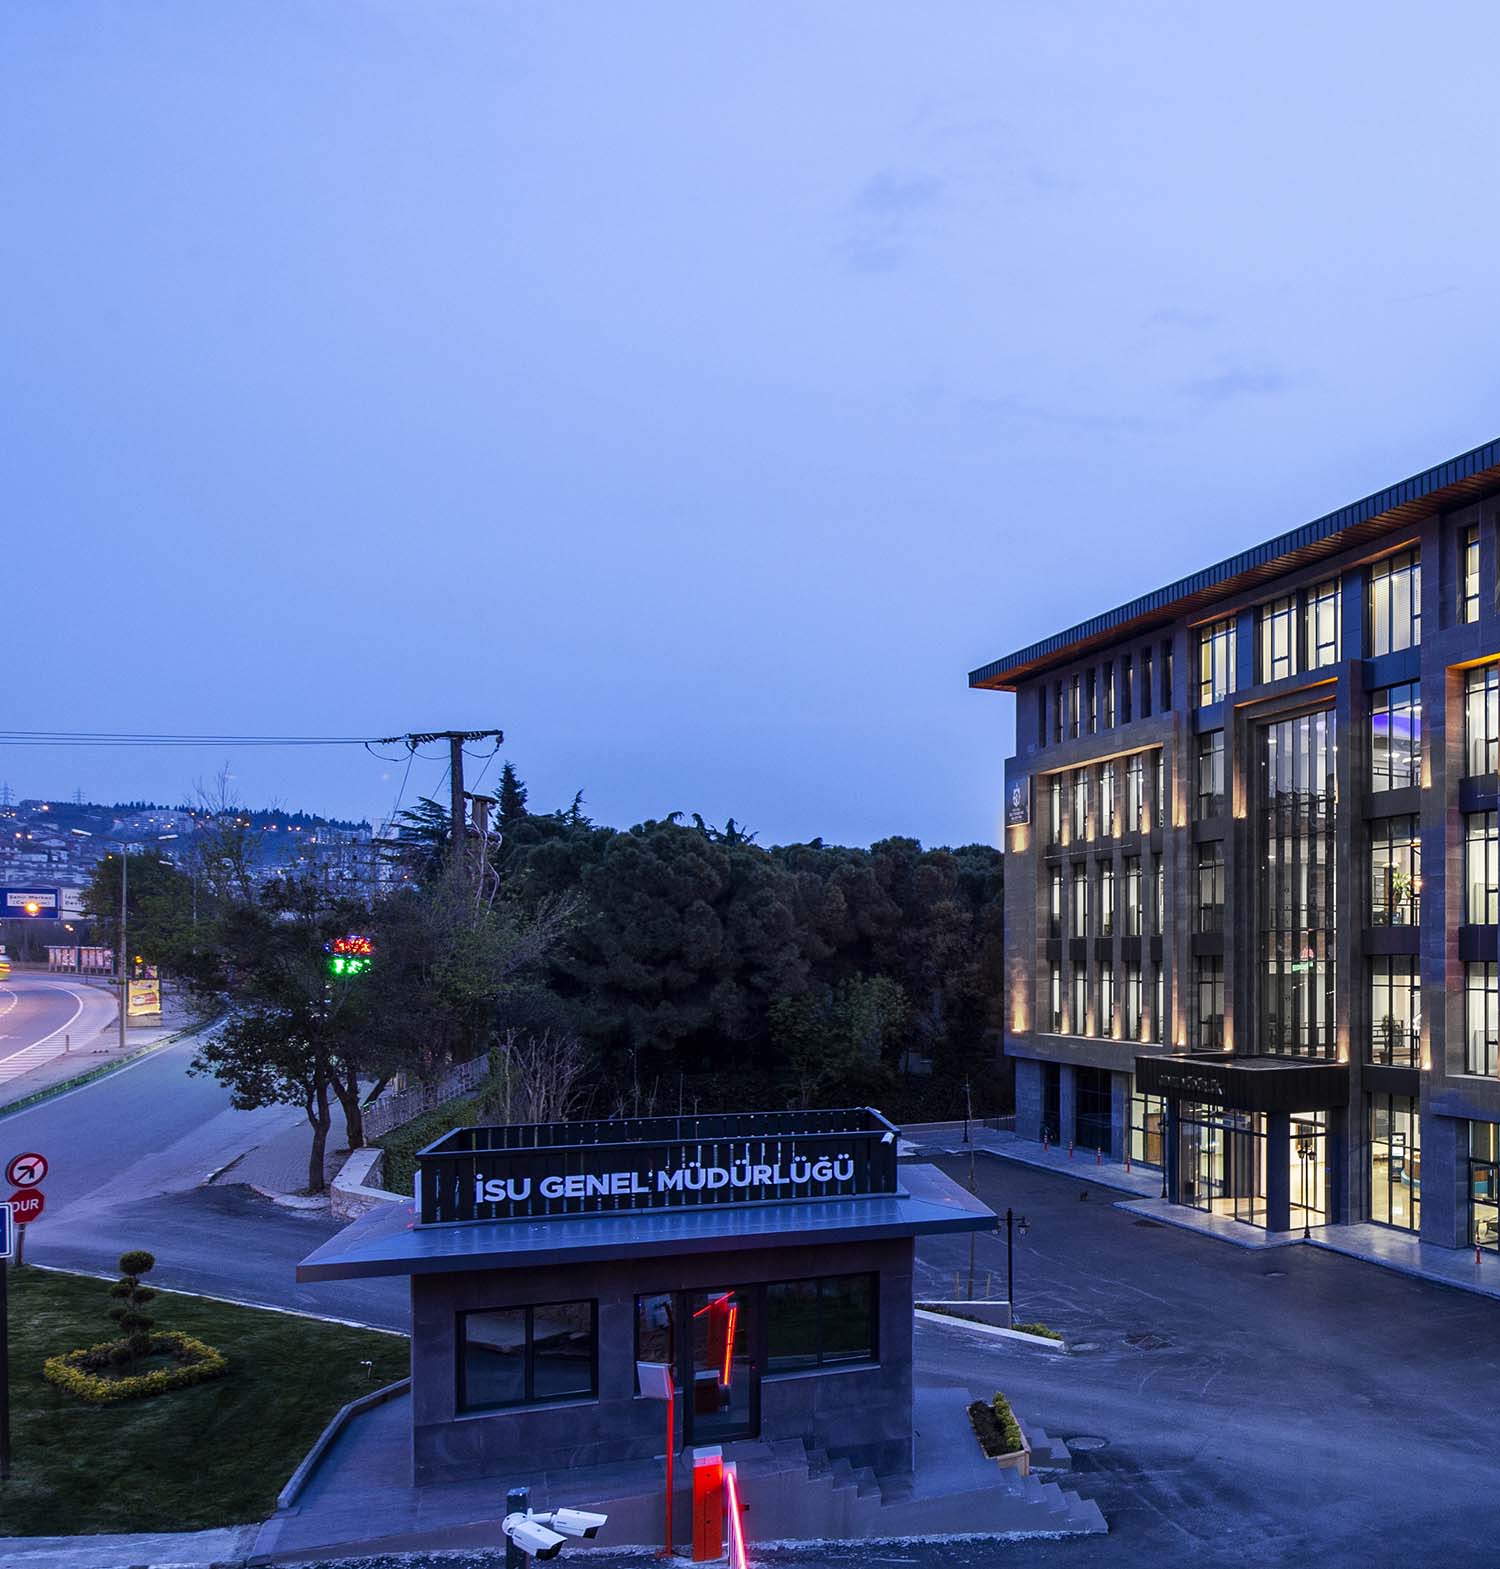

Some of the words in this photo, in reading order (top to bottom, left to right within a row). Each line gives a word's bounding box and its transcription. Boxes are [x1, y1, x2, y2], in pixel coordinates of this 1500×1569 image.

[475, 1173, 531, 1203] İSU
[539, 1171, 650, 1199] GENEL
[657, 1153, 855, 1192] MÜDÜRLÜĞÜ
[12, 1198, 40, 1212] DUR
